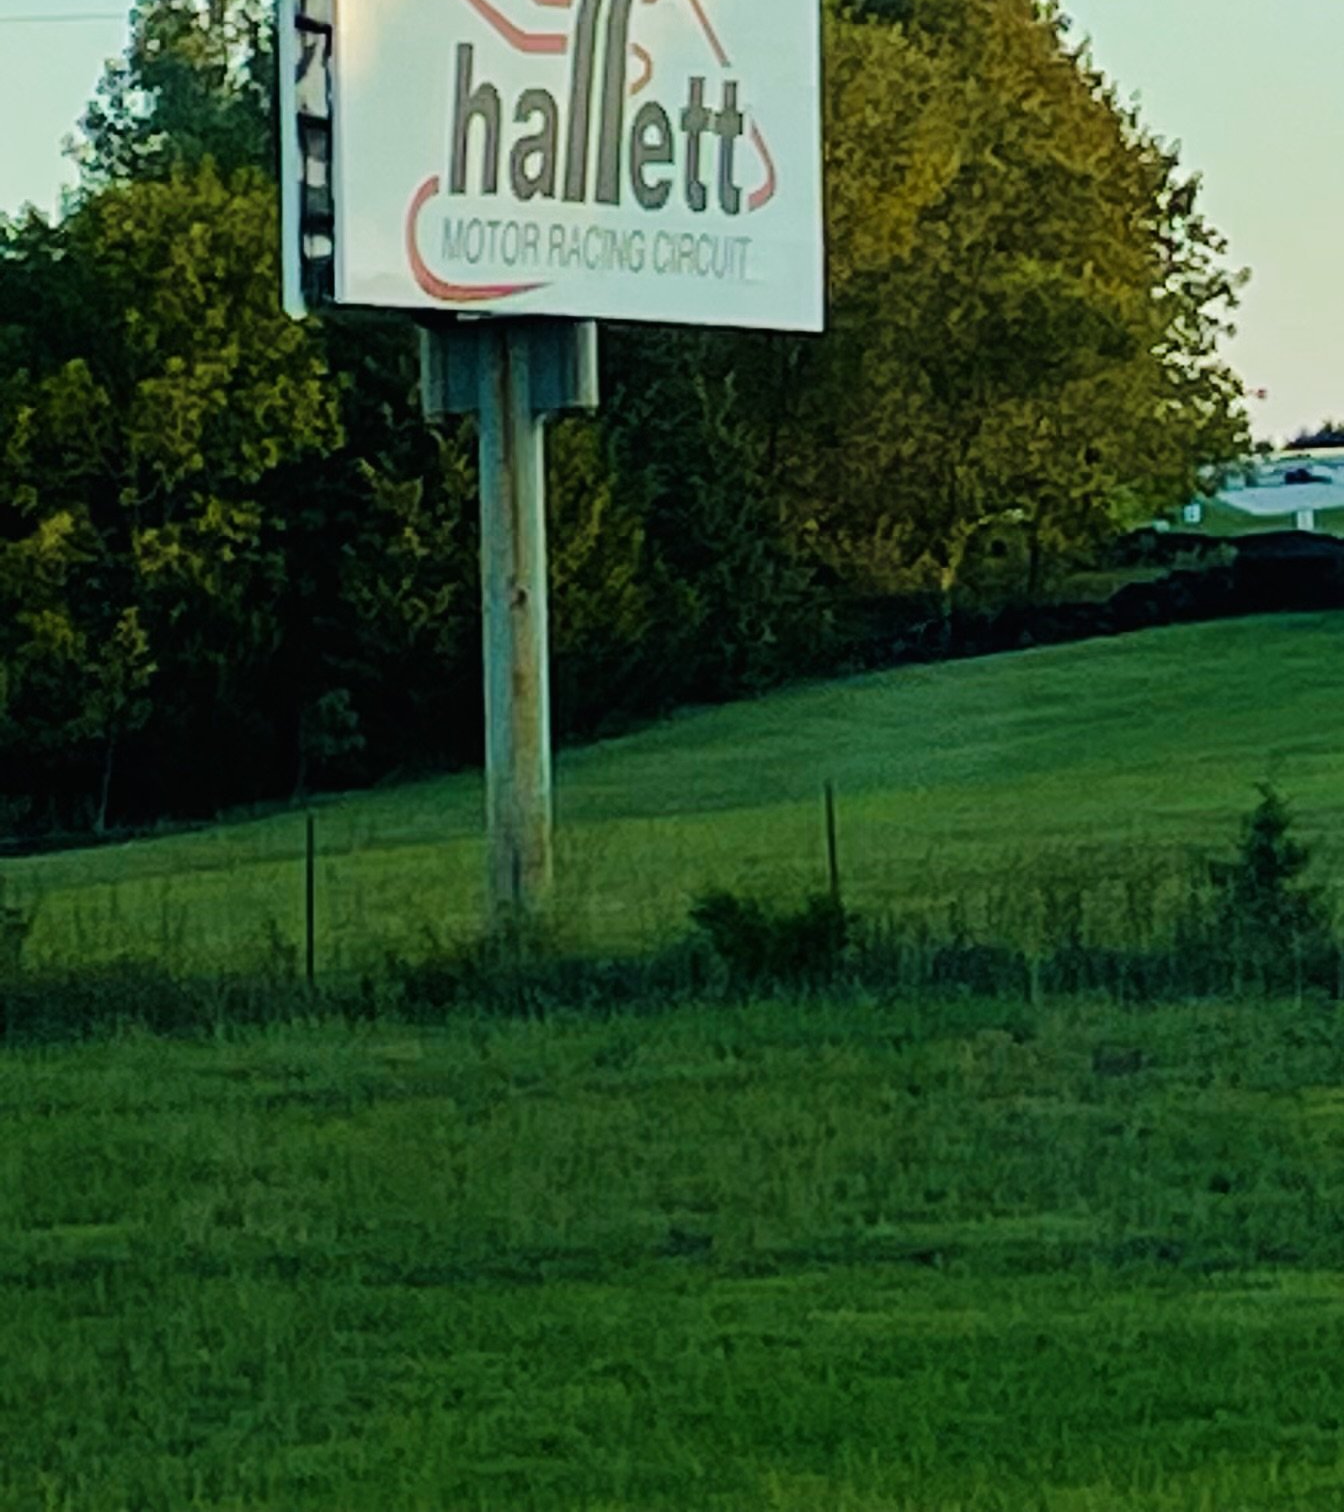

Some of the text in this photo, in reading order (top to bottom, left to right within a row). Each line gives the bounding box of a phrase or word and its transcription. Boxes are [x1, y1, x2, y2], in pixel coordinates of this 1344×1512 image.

[441, 217, 753, 279] MOTOR RACING CIRCUIT
